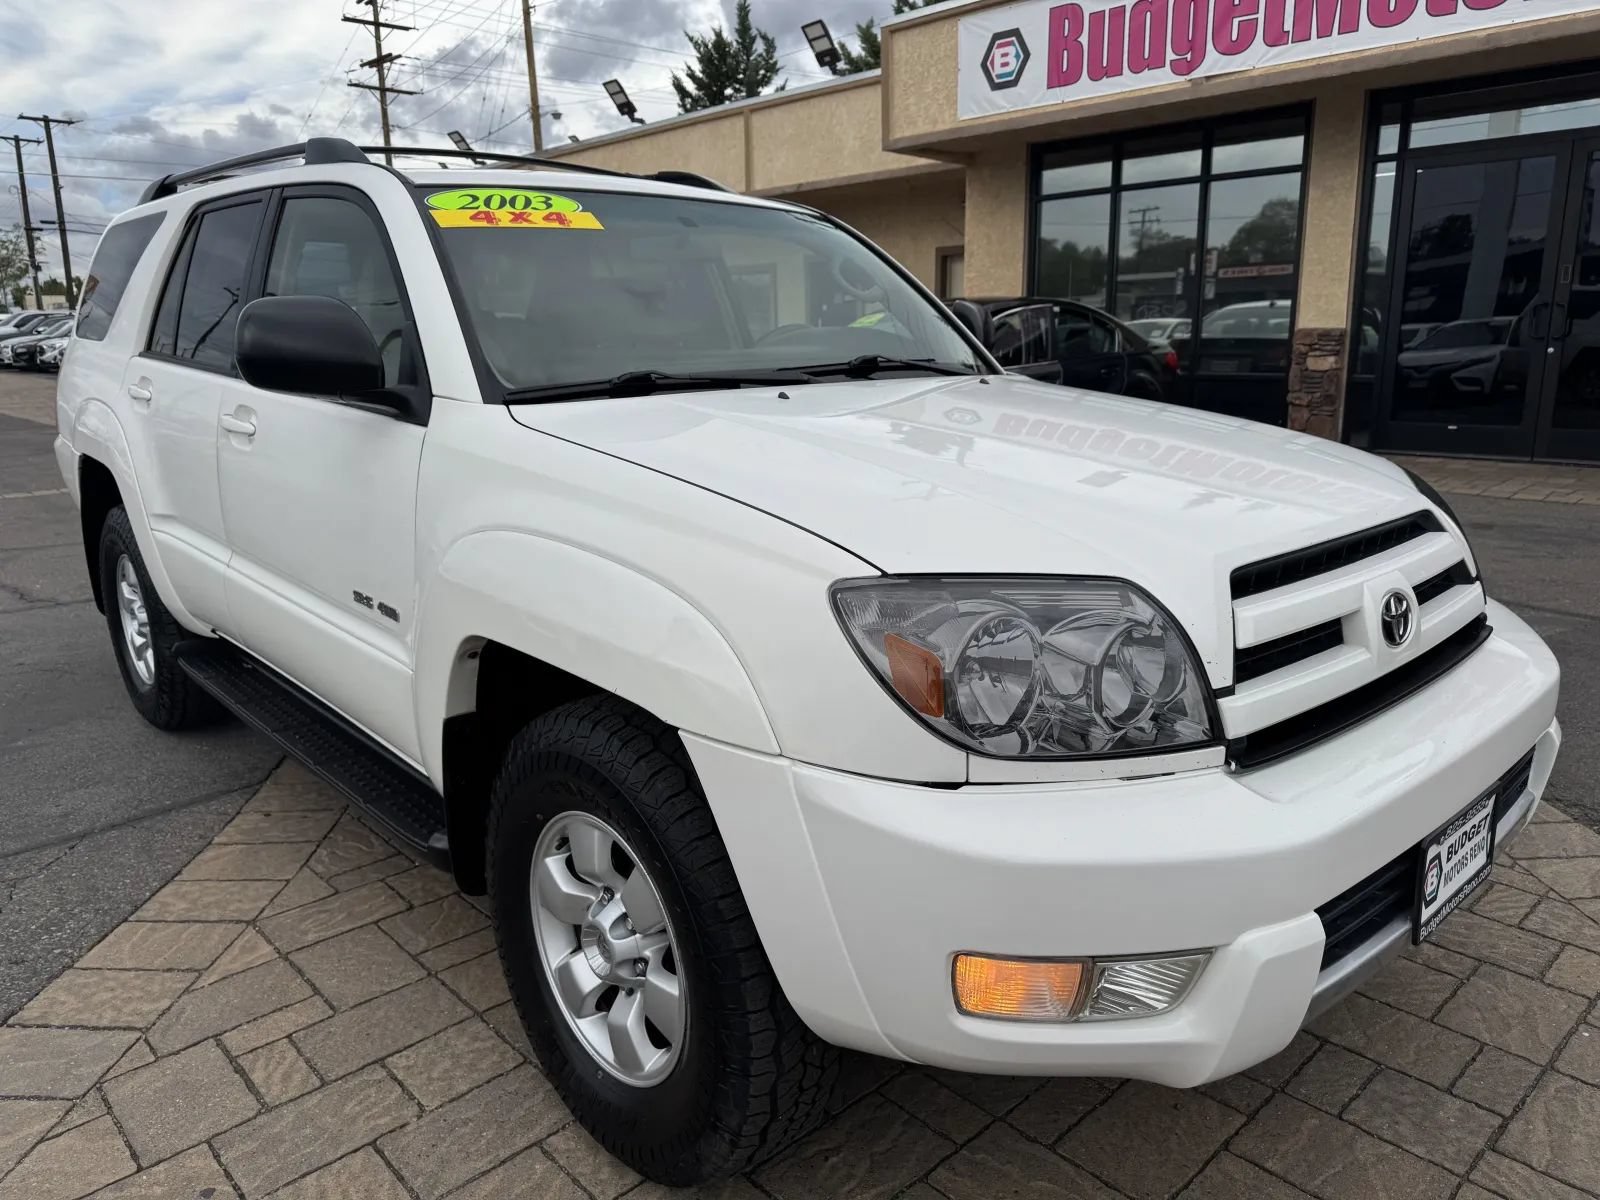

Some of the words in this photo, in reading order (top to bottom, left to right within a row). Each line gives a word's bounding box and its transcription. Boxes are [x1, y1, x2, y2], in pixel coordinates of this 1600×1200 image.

[457, 193, 553, 211] 2003
[1443, 850, 1469, 888] MOTORS
[1470, 835, 1486, 864] RENO
[1446, 812, 1490, 864] BUDGET
[1420, 864, 1491, 940] BudgetMotorsReno.com
